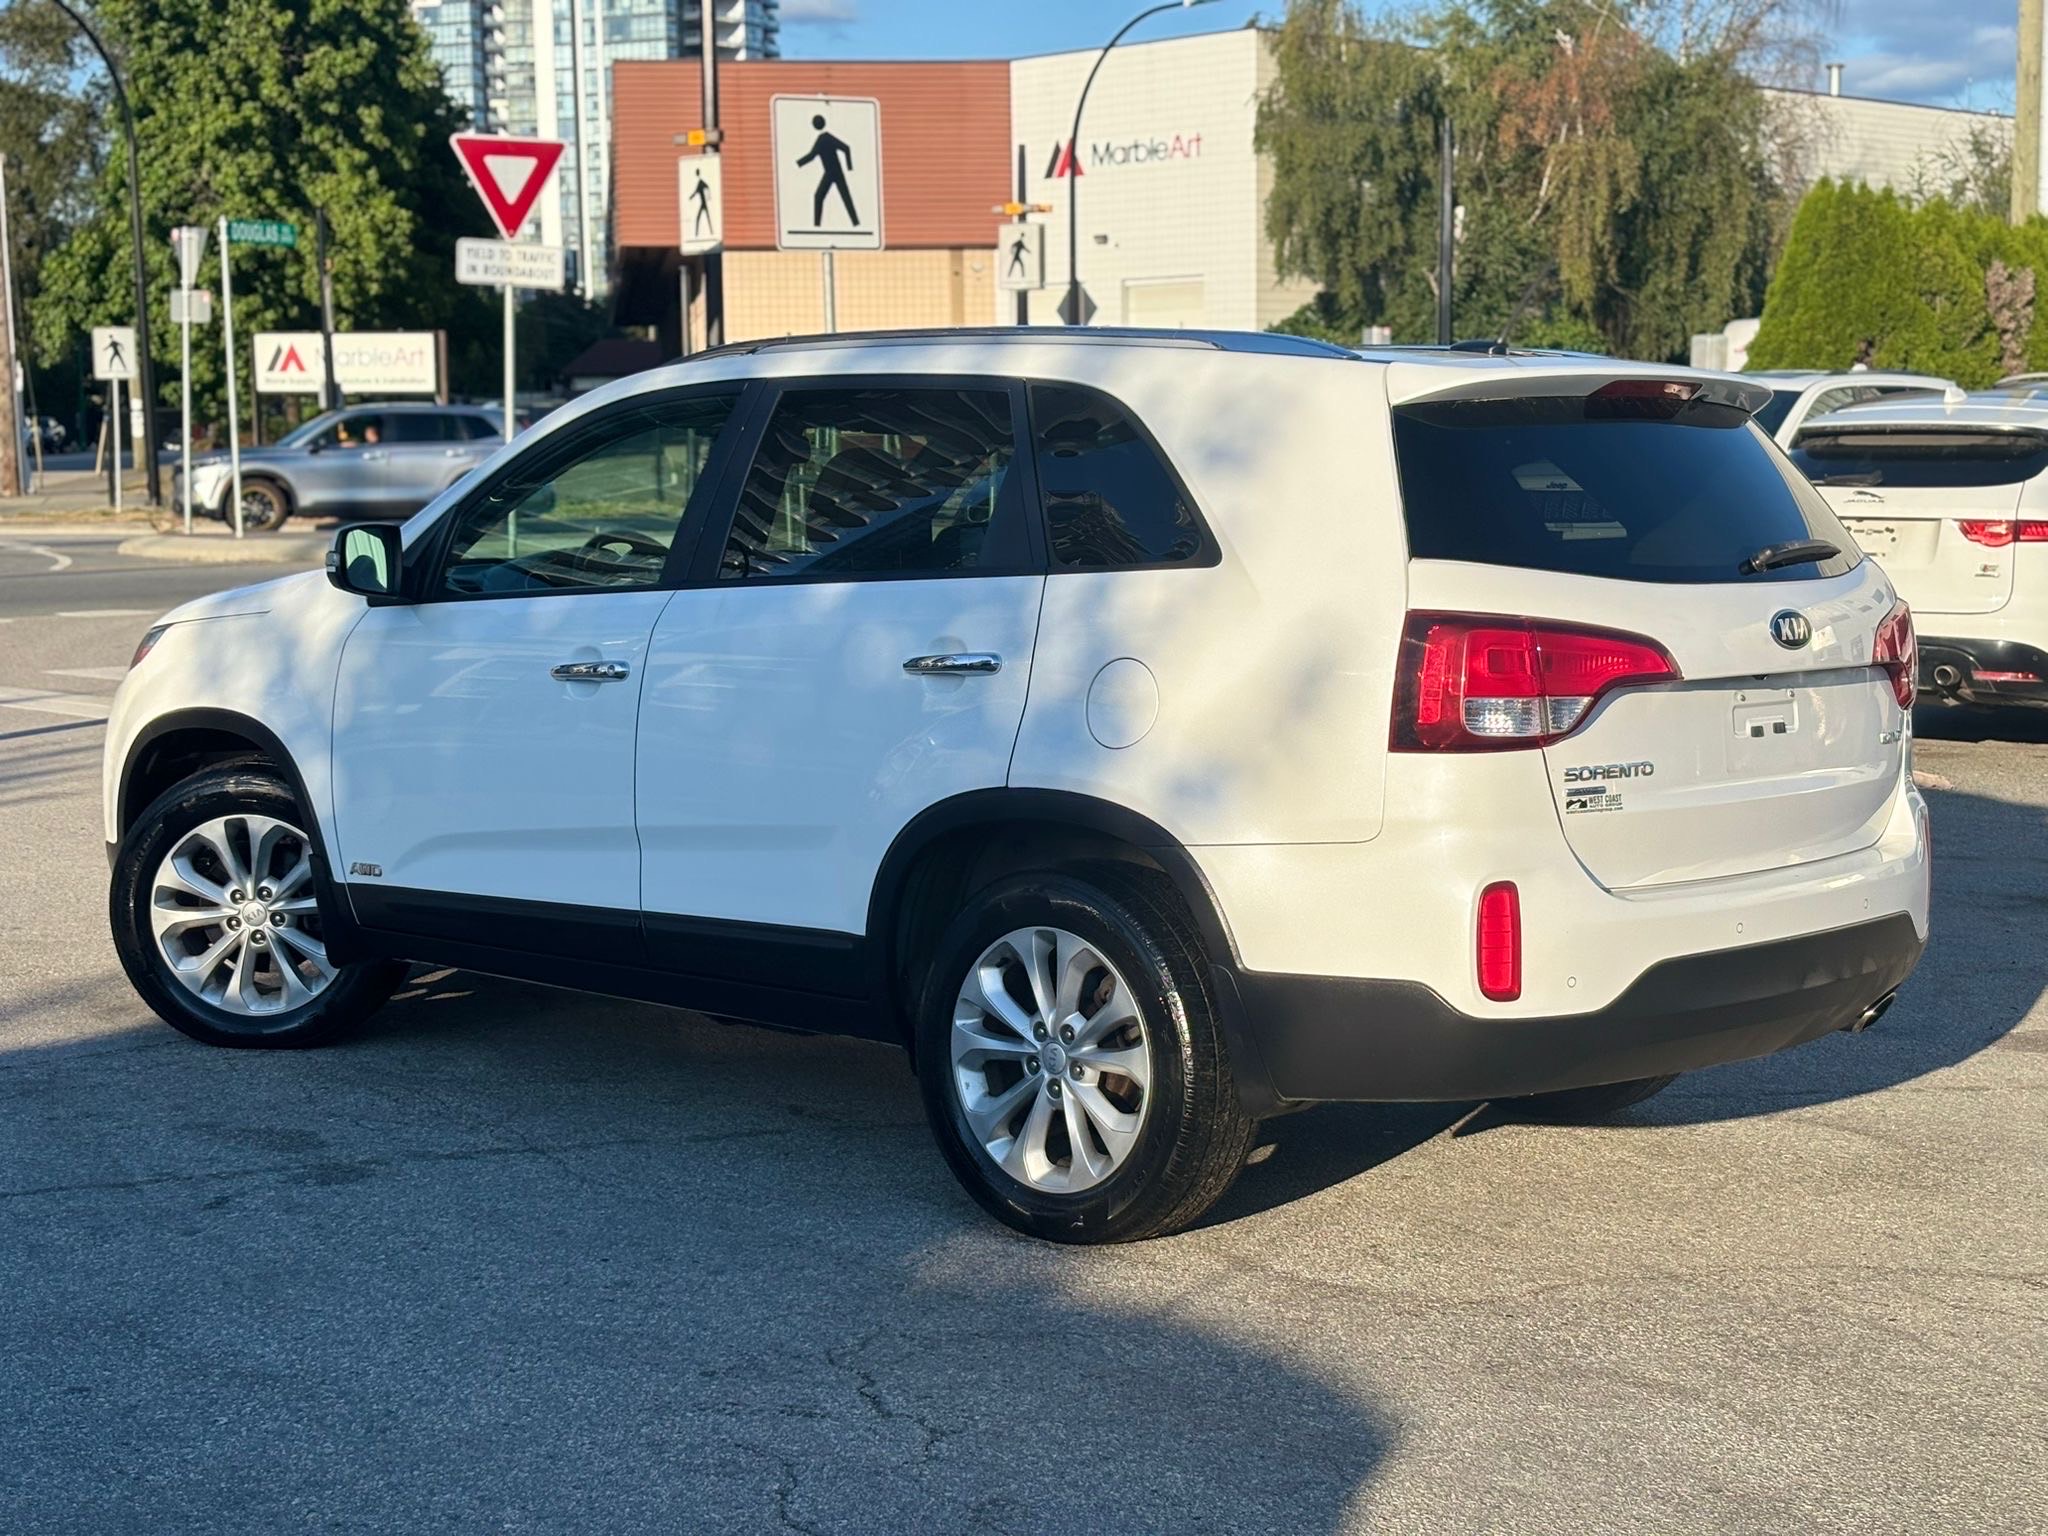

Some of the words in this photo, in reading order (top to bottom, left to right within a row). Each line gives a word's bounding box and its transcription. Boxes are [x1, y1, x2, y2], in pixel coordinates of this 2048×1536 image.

[1092, 132, 1203, 167] MarbleArt
[231, 222, 279, 243] DOUGLAS
[466, 247, 494, 260] YIELD
[500, 248, 512, 261] TO
[517, 250, 557, 265] TRAFFIC
[466, 264, 477, 275] IN
[484, 265, 555, 280] ROUNDABOUT
[1778, 617, 1809, 641] KIA
[1564, 761, 1655, 782] SORENTO
[1588, 795, 1603, 804] WEST
[1605, 793, 1622, 803] COAST
[350, 862, 383, 877] AWD
[245, 908, 264, 922] KIA
[1048, 1048, 1058, 1072] KIA
